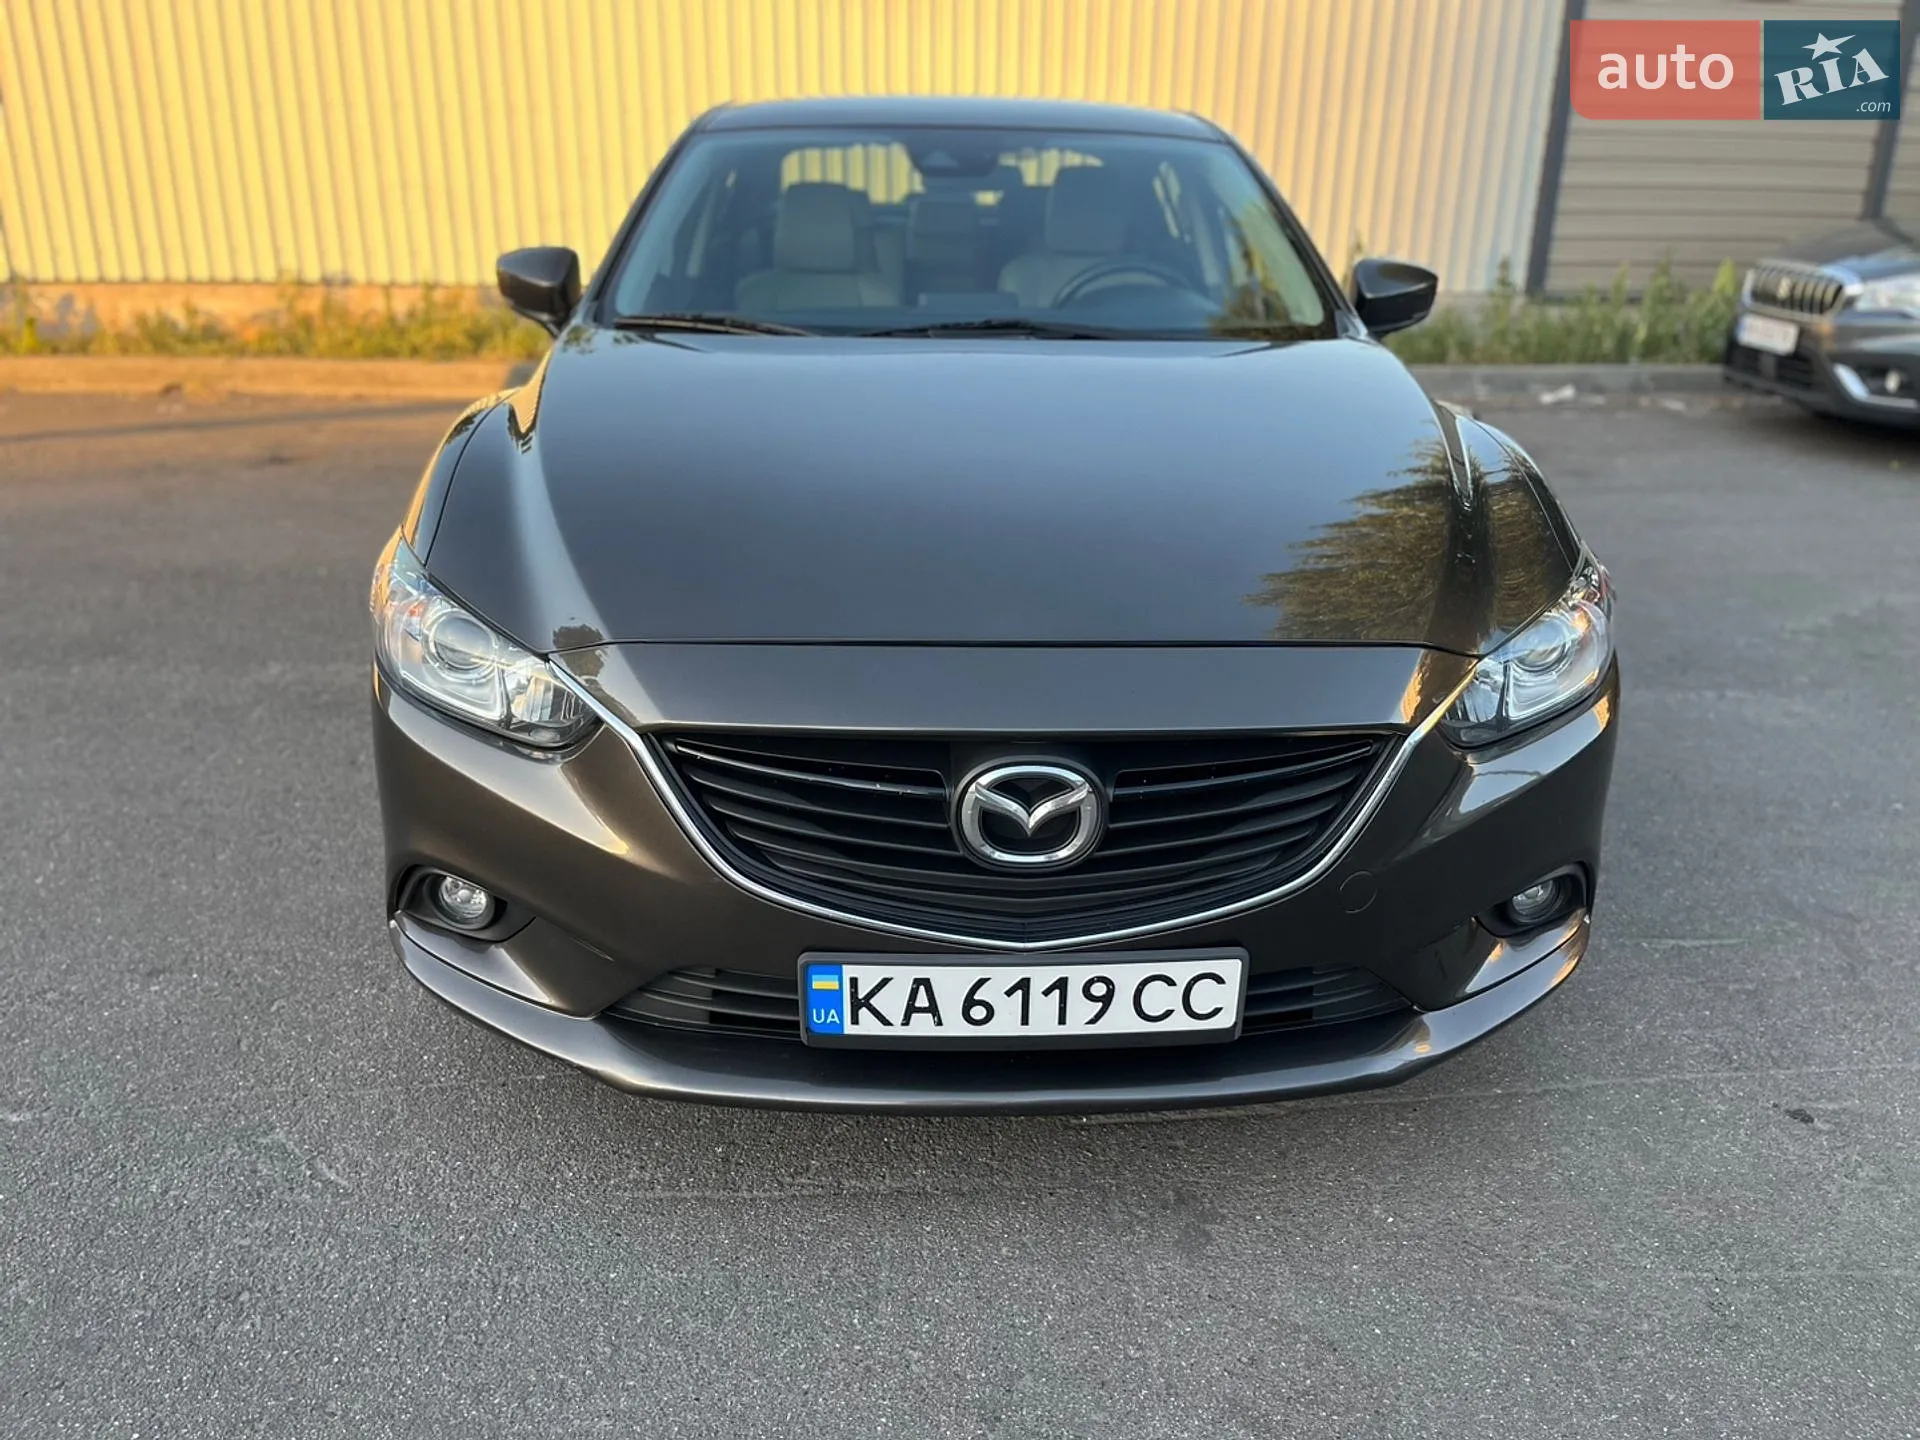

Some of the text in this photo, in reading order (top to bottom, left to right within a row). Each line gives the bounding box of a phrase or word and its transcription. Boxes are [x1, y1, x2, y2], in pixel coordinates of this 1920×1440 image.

[812, 1007, 841, 1025] UA
[848, 971, 1228, 1027] KA 6119 CC
